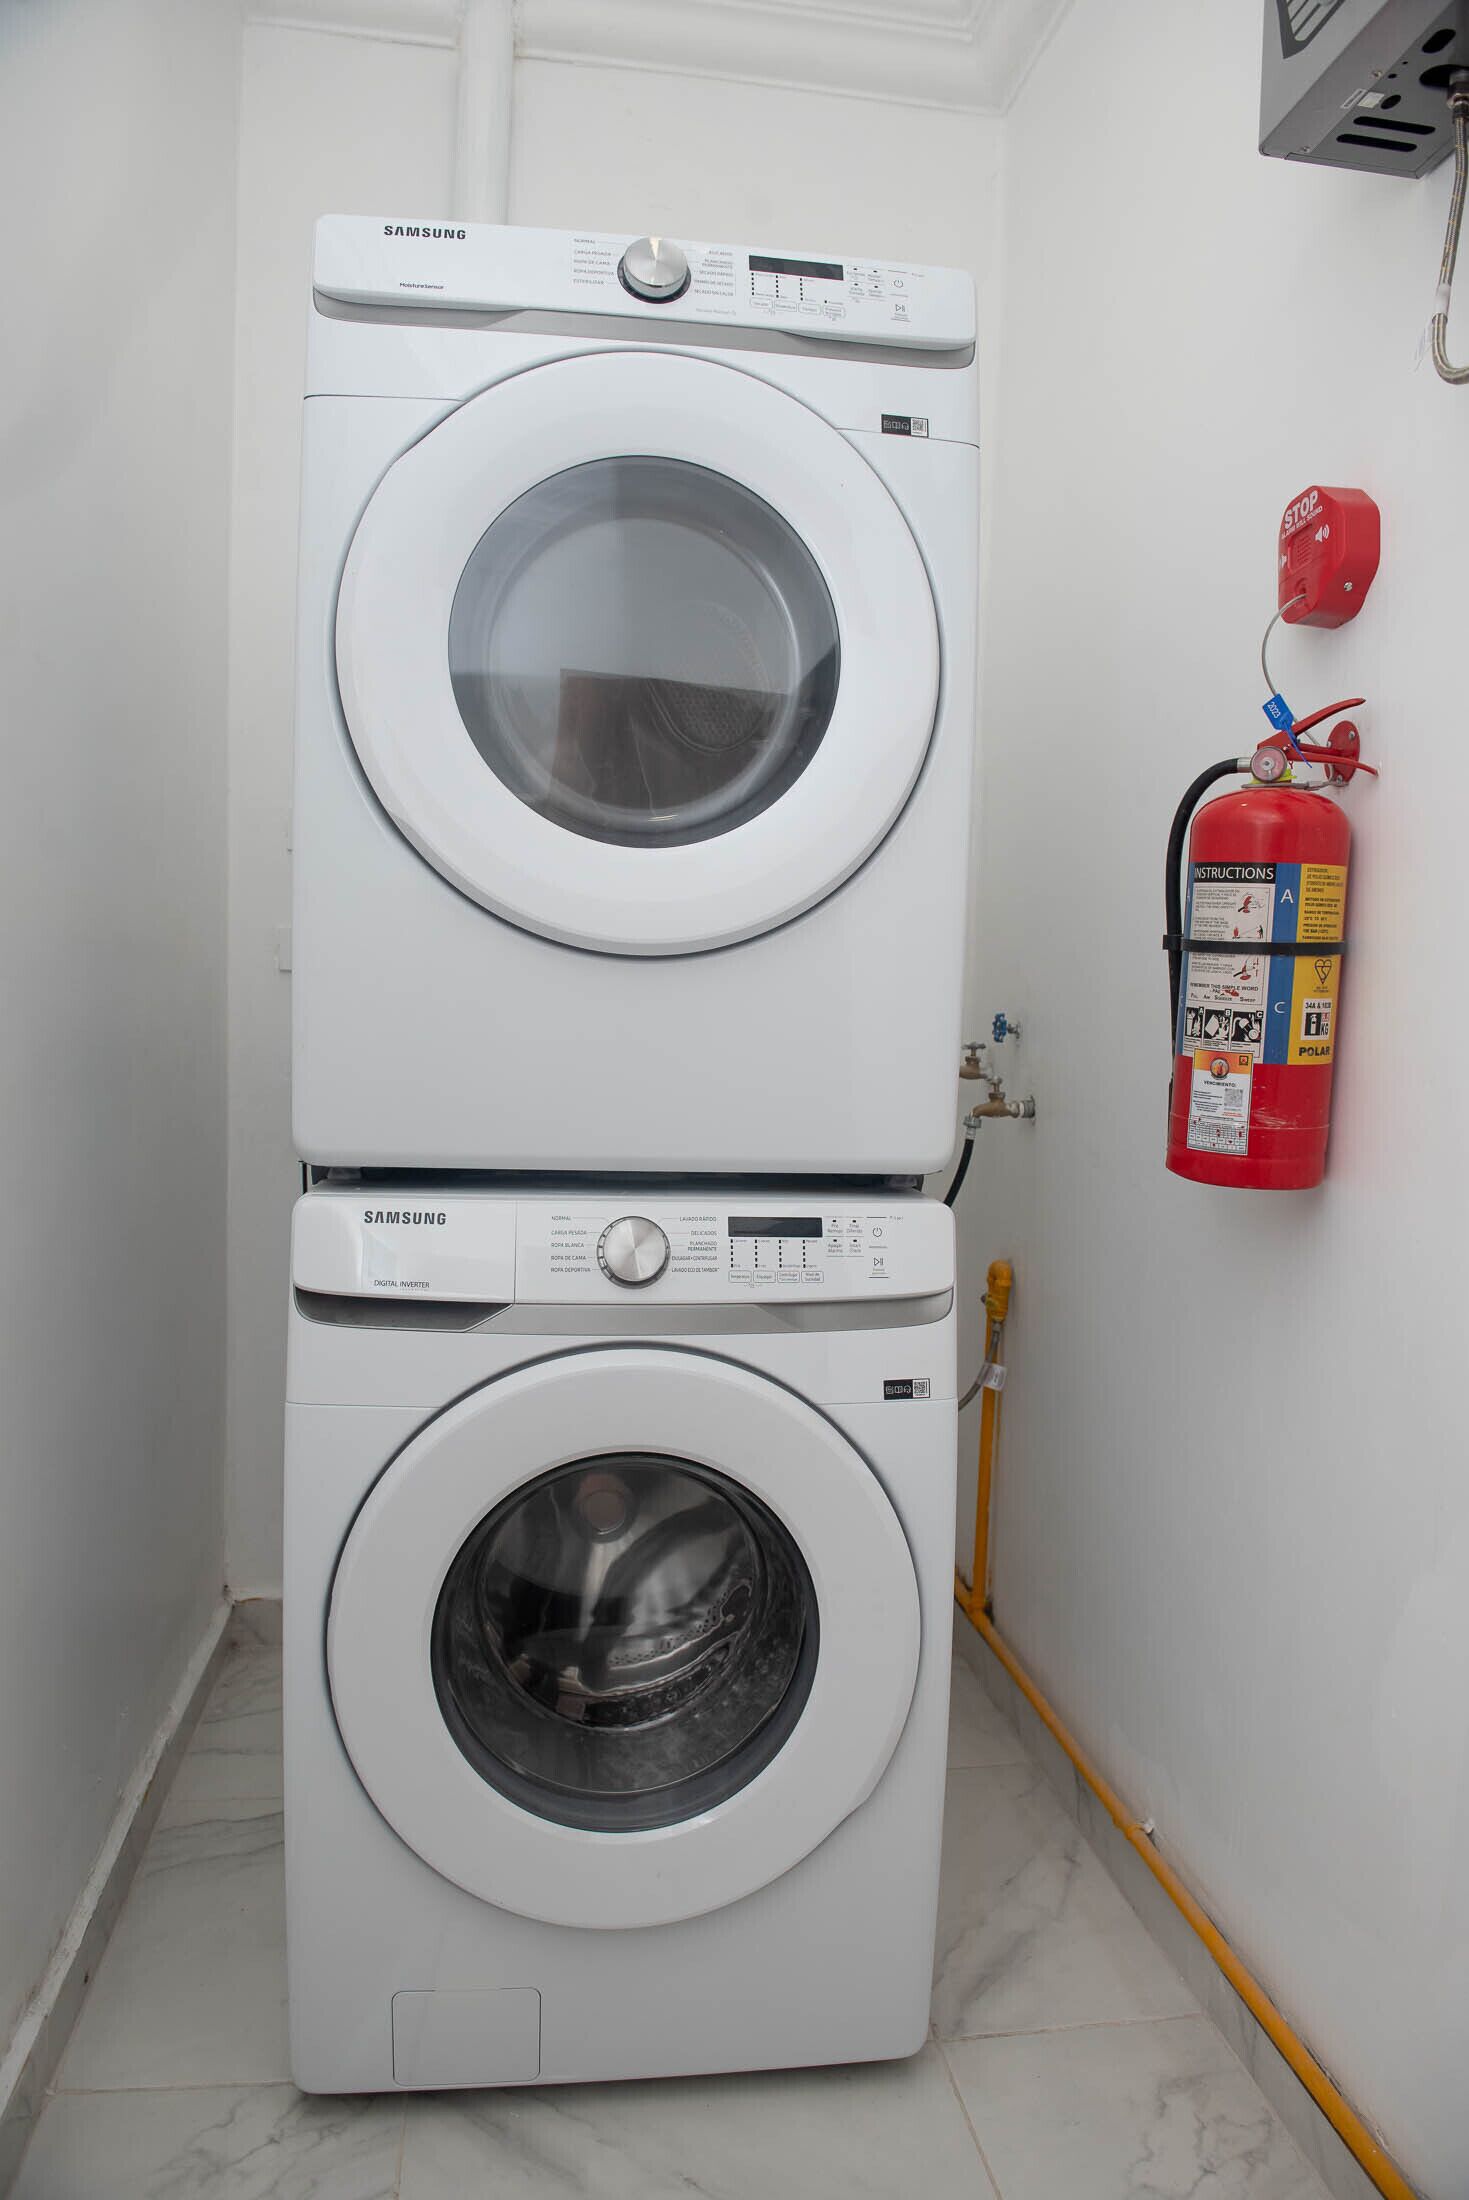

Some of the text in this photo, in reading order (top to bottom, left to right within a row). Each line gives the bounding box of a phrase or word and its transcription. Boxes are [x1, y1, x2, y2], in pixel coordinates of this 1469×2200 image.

[384, 225, 466, 240] SAMSUNG
[1285, 490, 1318, 530] STOP
[1195, 867, 1274, 880] INSTRUCTIONS
[1280, 889, 1294, 903] A
[1274, 1002, 1285, 1013] C
[1321, 1023, 1329, 1036] KG
[1299, 1046, 1330, 1056] POLAR
[364, 1210, 446, 1225] SAMSUNG
